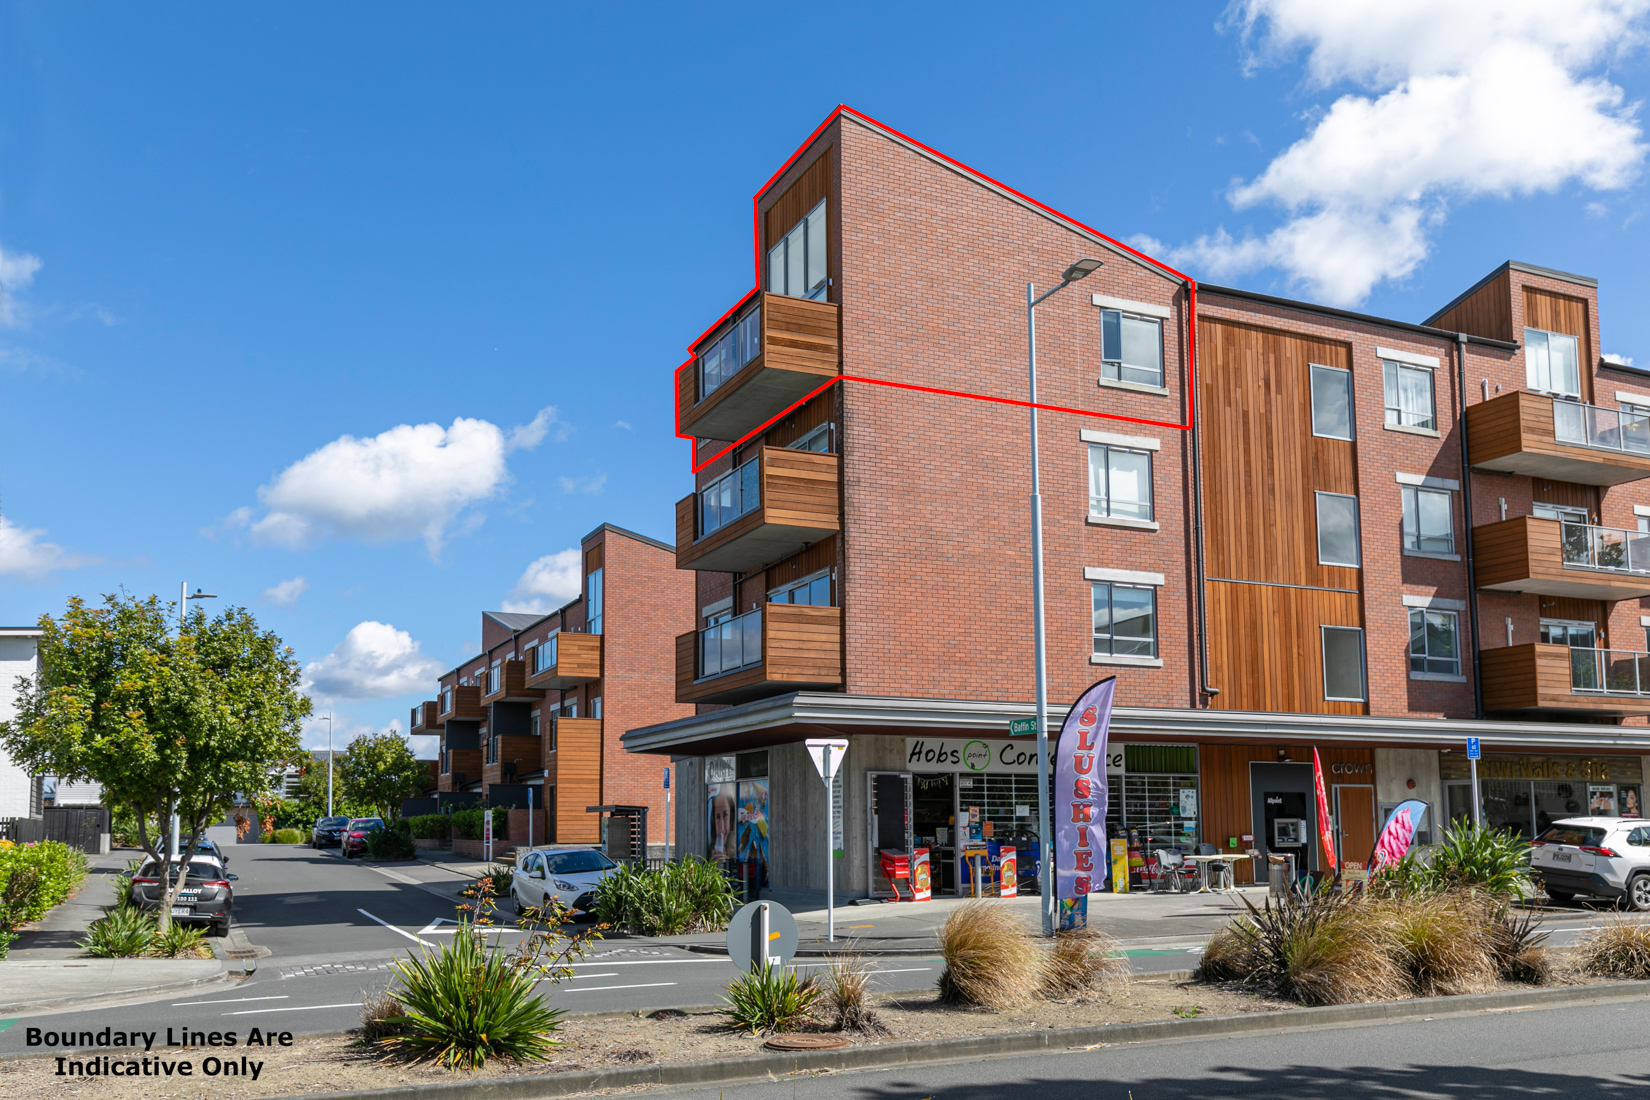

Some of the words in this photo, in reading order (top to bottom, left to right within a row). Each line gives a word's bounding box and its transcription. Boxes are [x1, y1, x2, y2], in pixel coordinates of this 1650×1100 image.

[1013, 721, 1030, 733] Baffin
[1030, 720, 1037, 731] St
[908, 740, 961, 765] Hobs
[966, 748, 989, 761] point
[999, 743, 1123, 768] Conece
[1331, 762, 1373, 775] crown
[1477, 756, 1516, 779] Kiwi
[1517, 757, 1562, 779] Nails
[1565, 761, 1576, 779] &
[1579, 757, 1611, 782] Spa
[1071, 704, 1098, 896] SLUSHIES
[1344, 861, 1363, 870] OPEN
